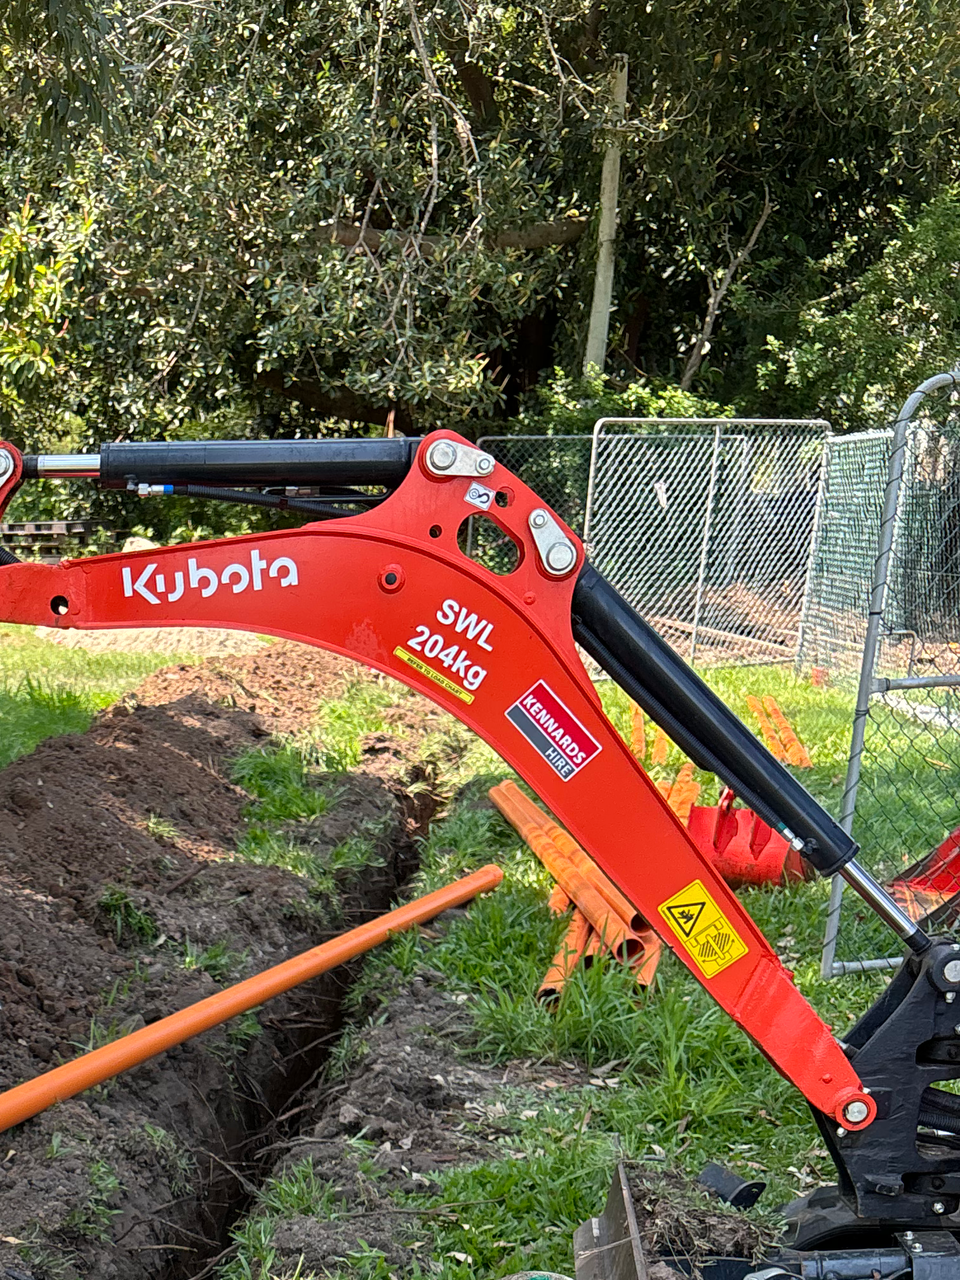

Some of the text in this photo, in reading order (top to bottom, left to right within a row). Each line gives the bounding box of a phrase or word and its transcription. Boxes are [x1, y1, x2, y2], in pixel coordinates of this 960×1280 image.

[122, 549, 299, 605] Kubota
[436, 599, 493, 652] SWL
[407, 625, 487, 691] 204kg
[407, 657, 462, 696] REFER TO LOAD CHART
[522, 694, 586, 764] KENNARDS
[545, 747, 573, 777] HIRE
